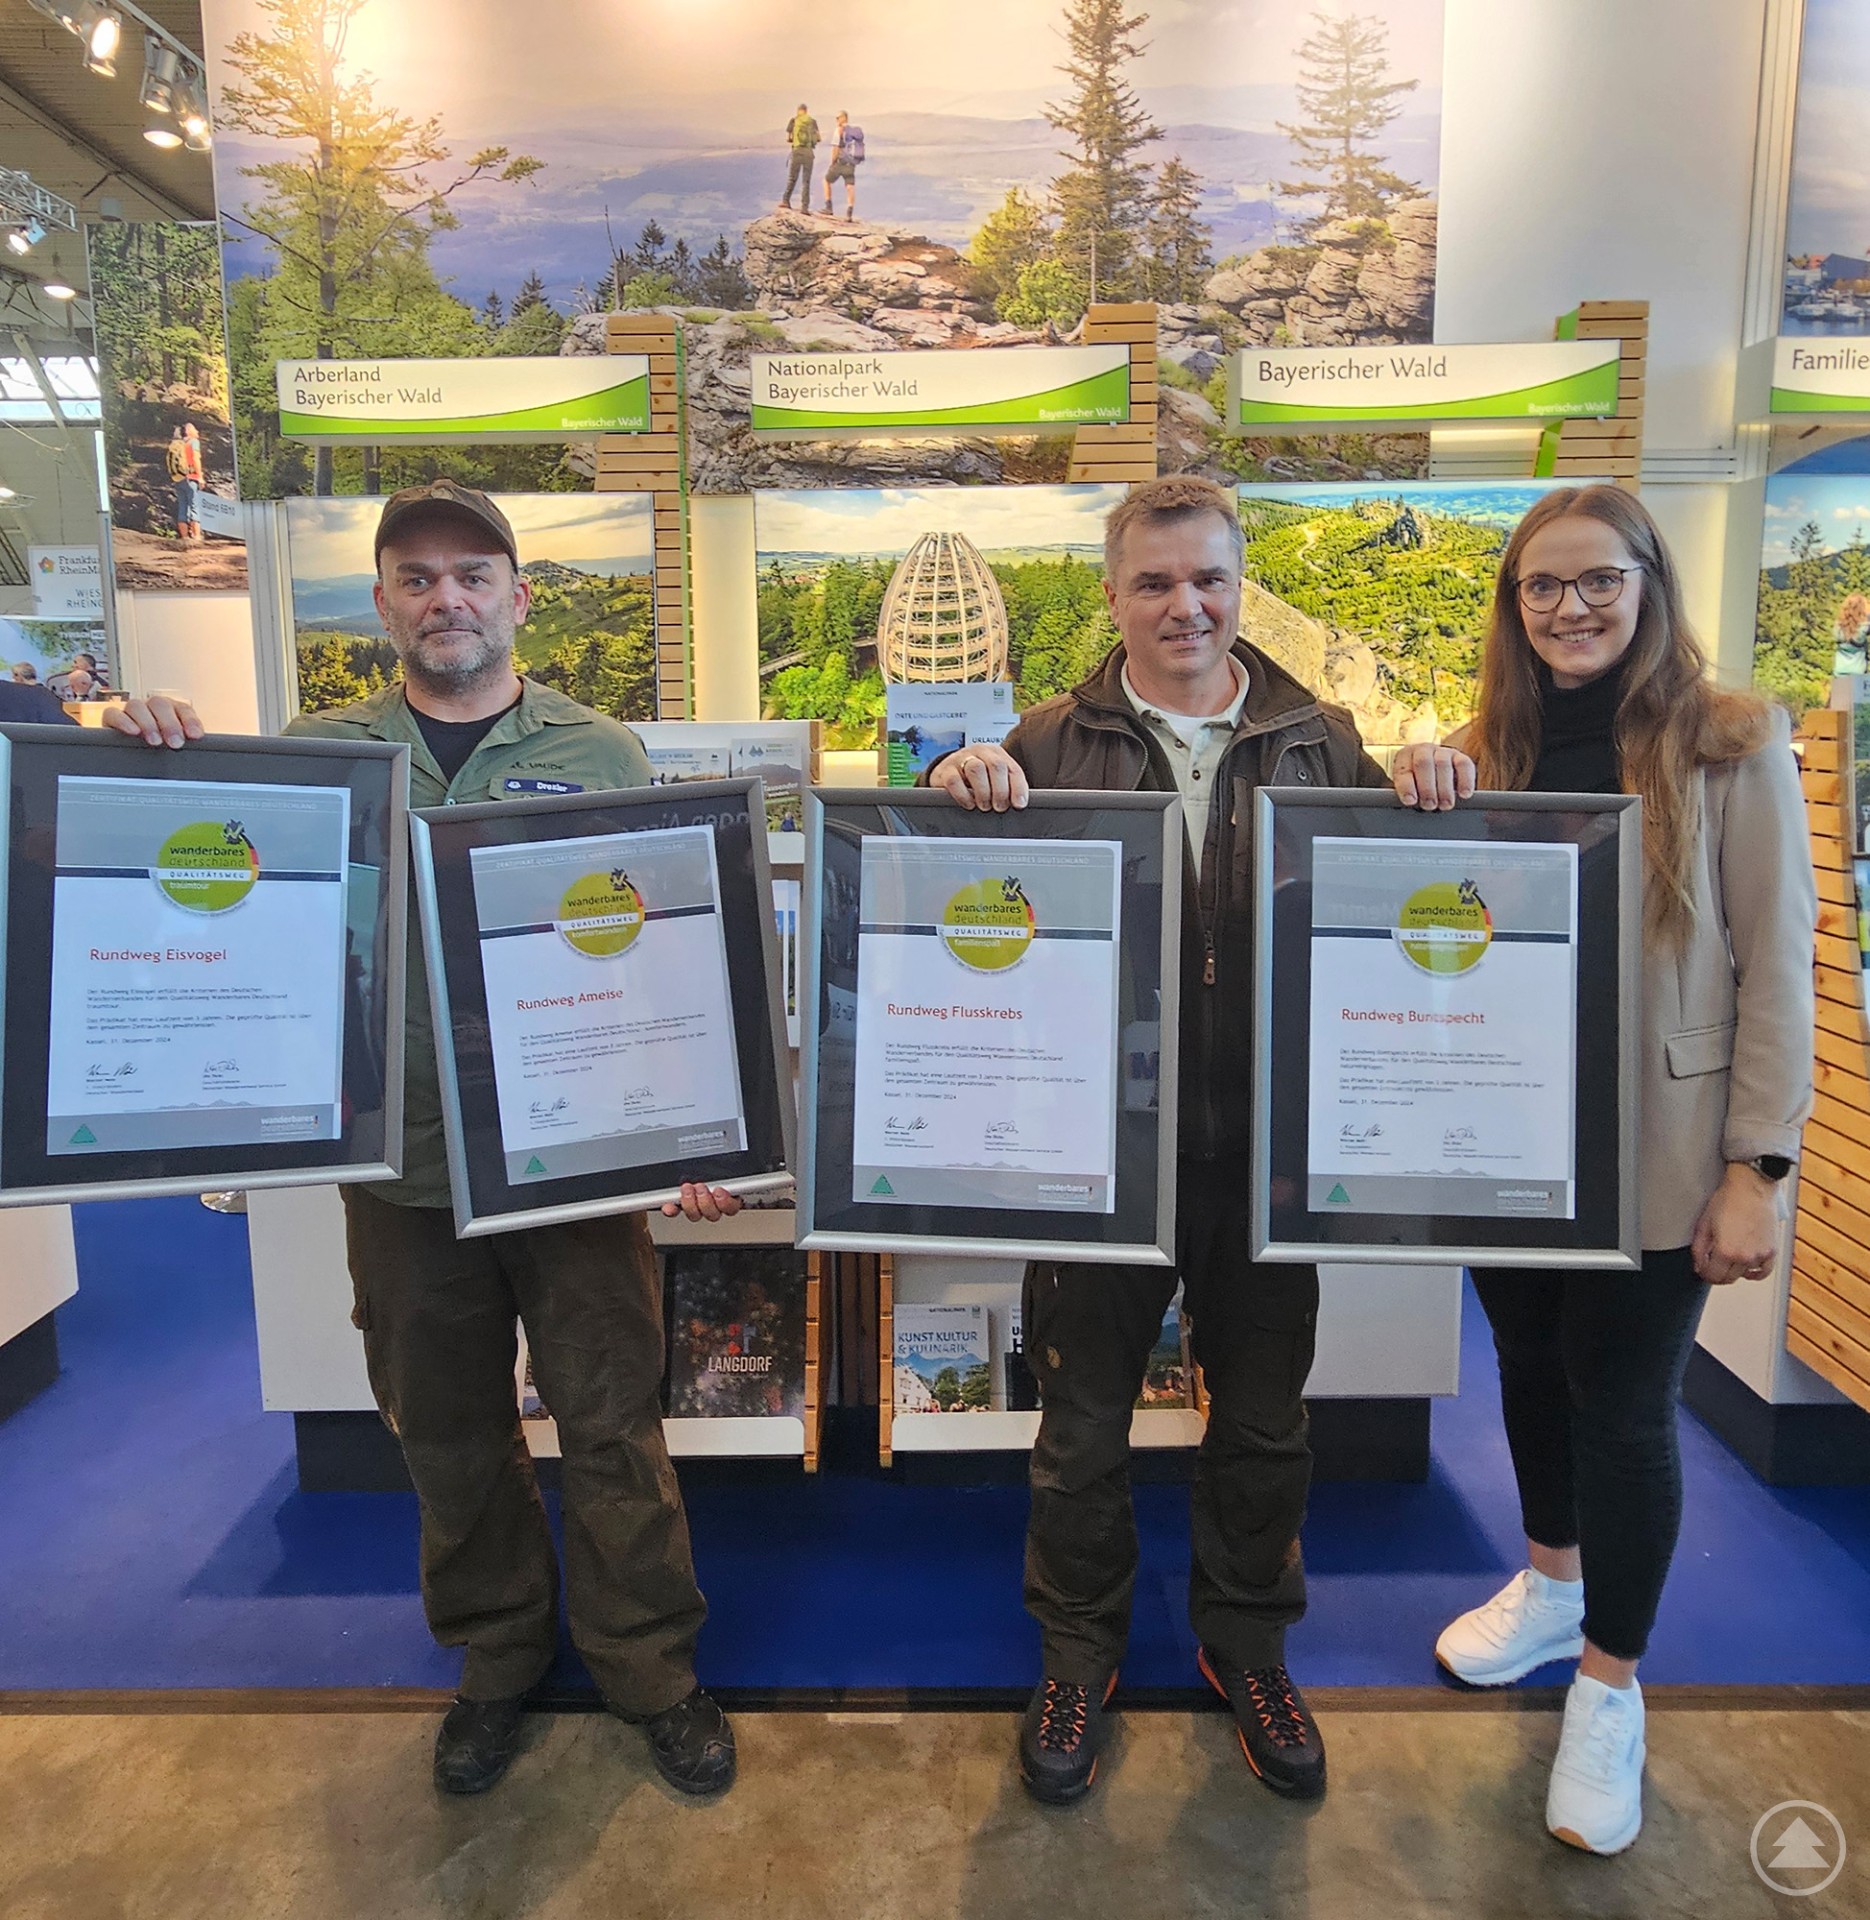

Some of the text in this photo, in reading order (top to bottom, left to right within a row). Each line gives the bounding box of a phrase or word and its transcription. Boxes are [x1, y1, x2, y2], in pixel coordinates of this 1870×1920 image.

[294, 366, 381, 383] Arberland
[768, 358, 883, 380] Nationalpark
[1258, 356, 1448, 388] Bayerischer Wald
[296, 387, 442, 410] Bayerischer Wald
[768, 380, 918, 403] Bayerischer Wald
[1038, 407, 1121, 421] Bayerischer Wald
[1527, 402, 1611, 416] Bayerischer Wald
[561, 416, 643, 430] Bayerischer Wald
[169, 846, 245, 857] wanderbares
[169, 857, 245, 868] deutschland
[567, 894, 631, 908] wanderbares
[954, 903, 1022, 914] wanderbares
[1409, 906, 1479, 917] wanderbares
[954, 914, 1022, 925] deutschland
[954, 928, 1022, 937] QUALITÄTSWEG
[90, 948, 228, 963] Rundweg Eisvogel
[517, 989, 624, 1011] Rundweg Ameise
[887, 1003, 1023, 1020] Rundweg Flusskrebs
[1341, 1009, 1485, 1025] Rundweg Buntspecht
[898, 1331, 978, 1342] KUNST KULTUR
[707, 1355, 773, 1373] LANGDORF
